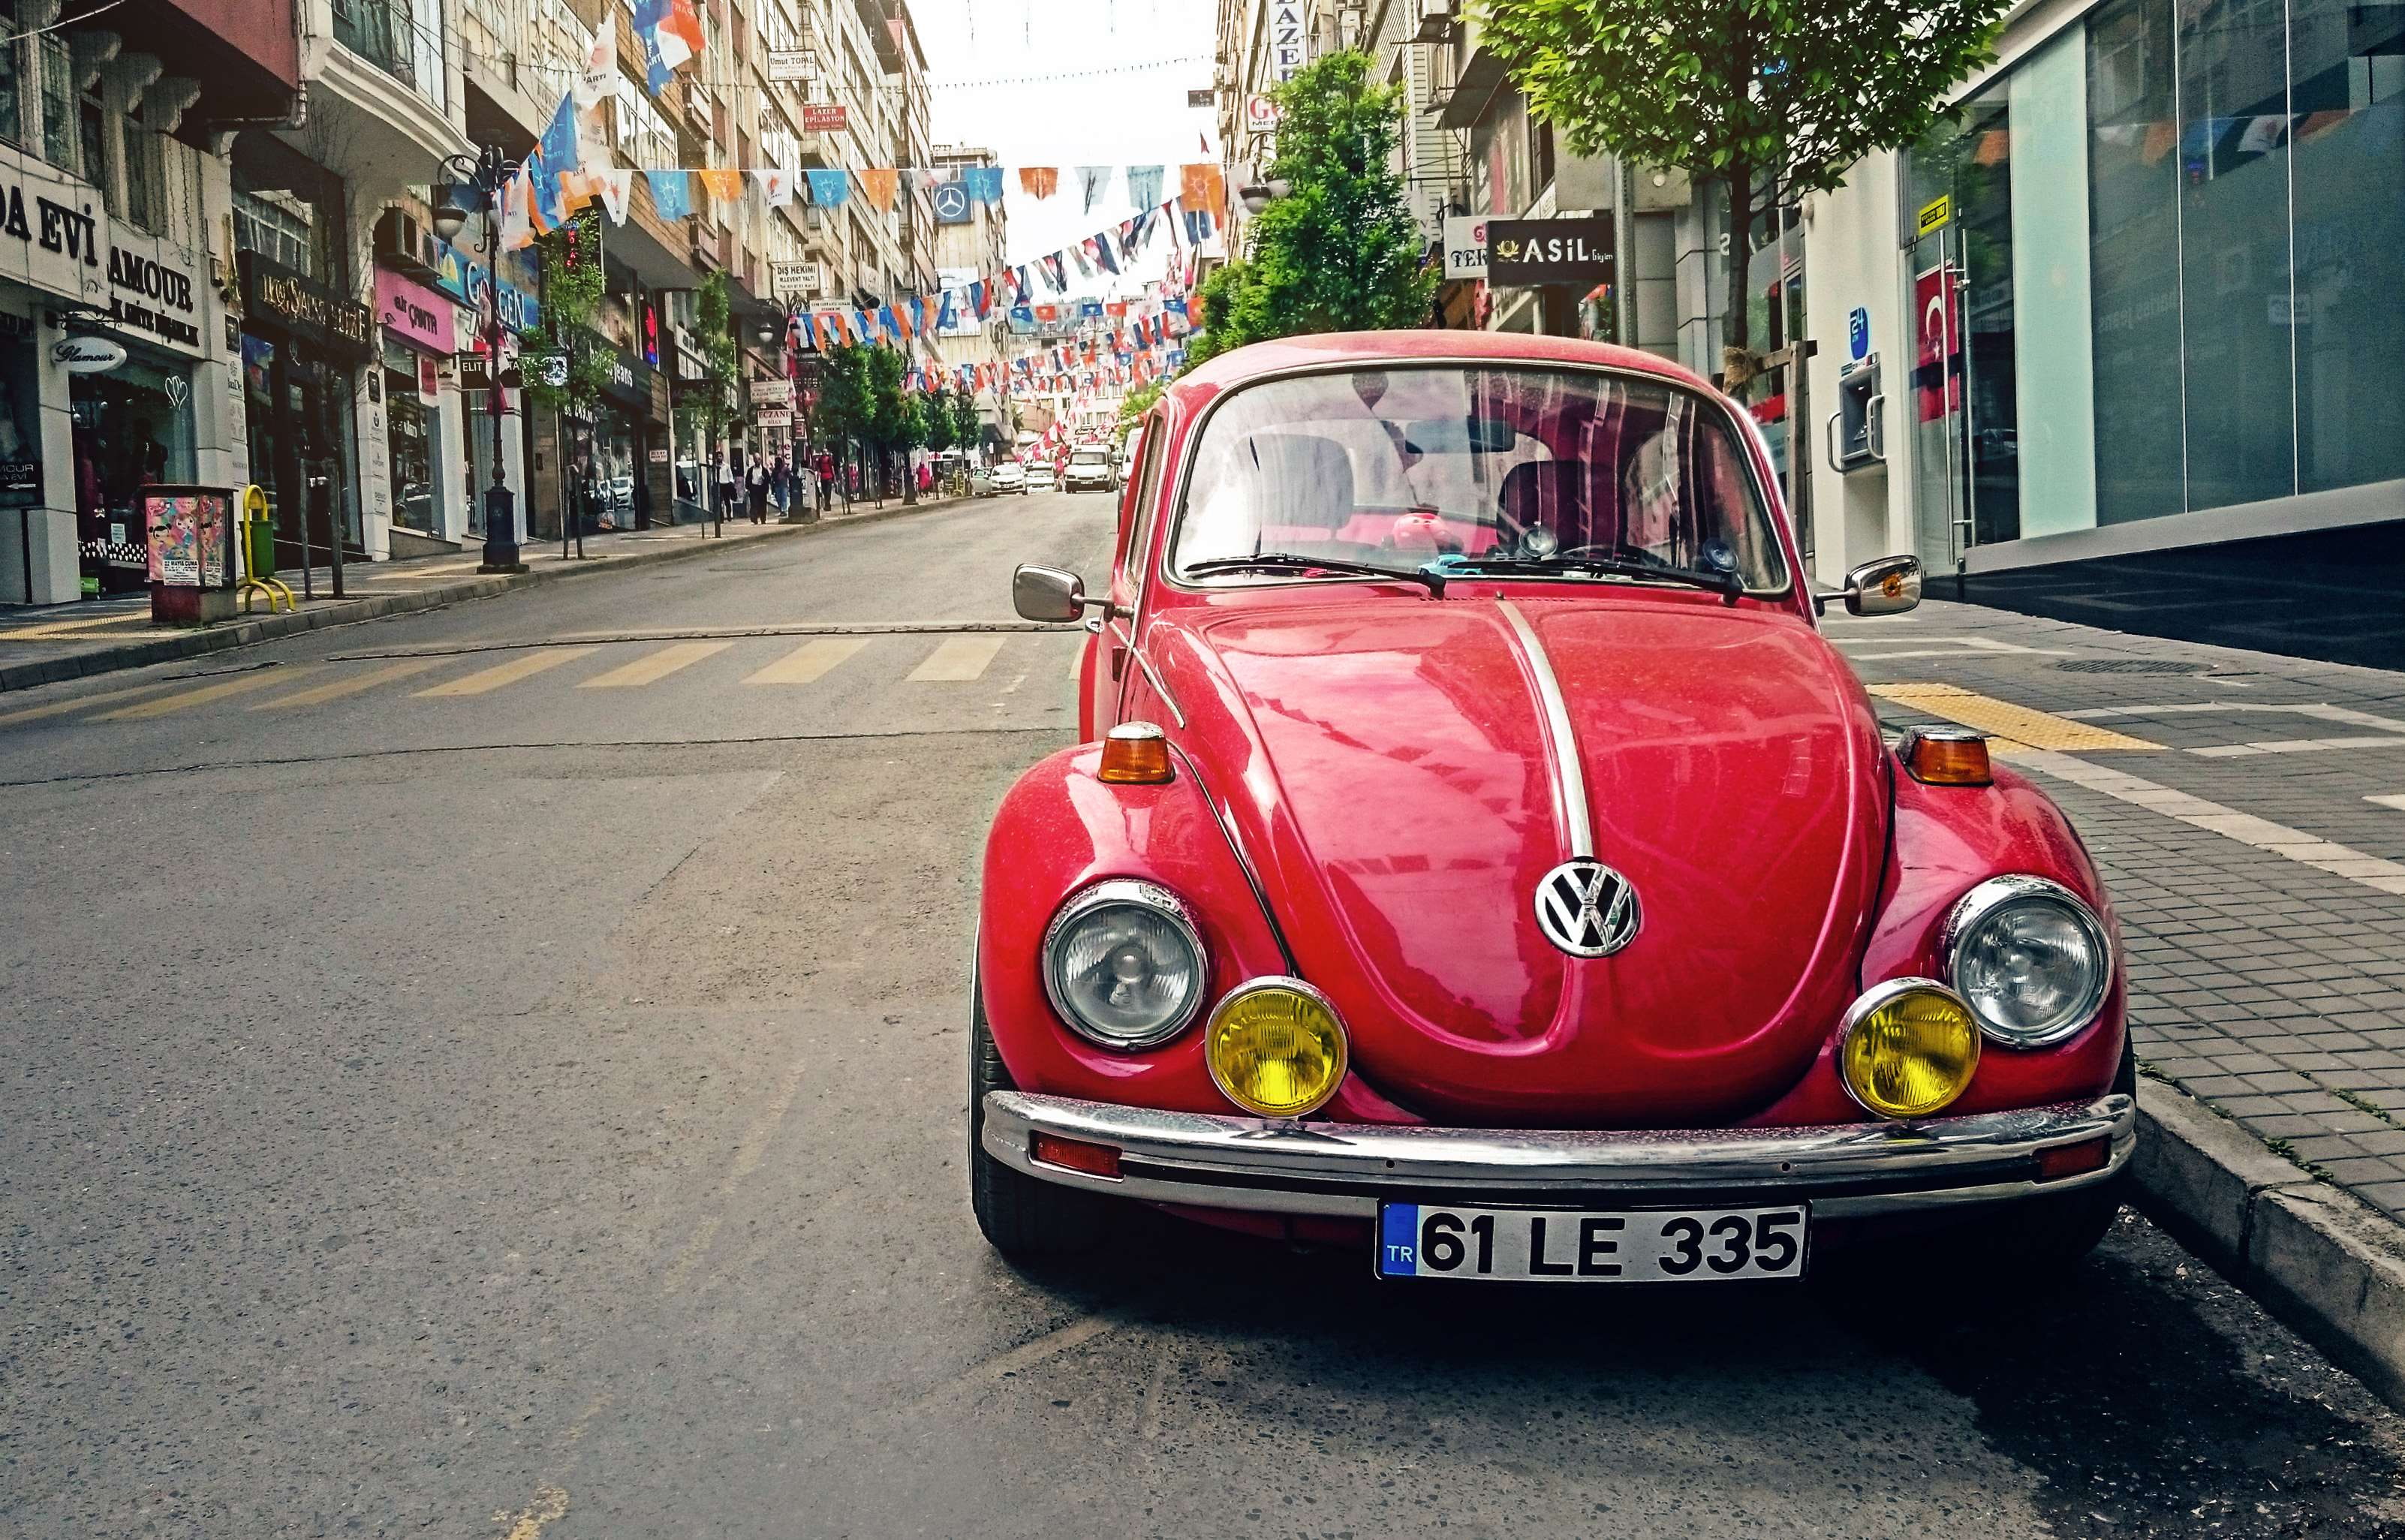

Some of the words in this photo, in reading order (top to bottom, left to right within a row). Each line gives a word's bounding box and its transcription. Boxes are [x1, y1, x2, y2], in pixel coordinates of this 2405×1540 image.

[36, 195, 99, 266] EVİ
[107, 245, 194, 313] AMOUR
[55, 344, 116, 362] Glamour
[1386, 1244, 1413, 1262] TR
[1421, 1211, 1495, 1274] 61
[1529, 1217, 1627, 1277] LE
[1657, 1210, 1801, 1276] 335
